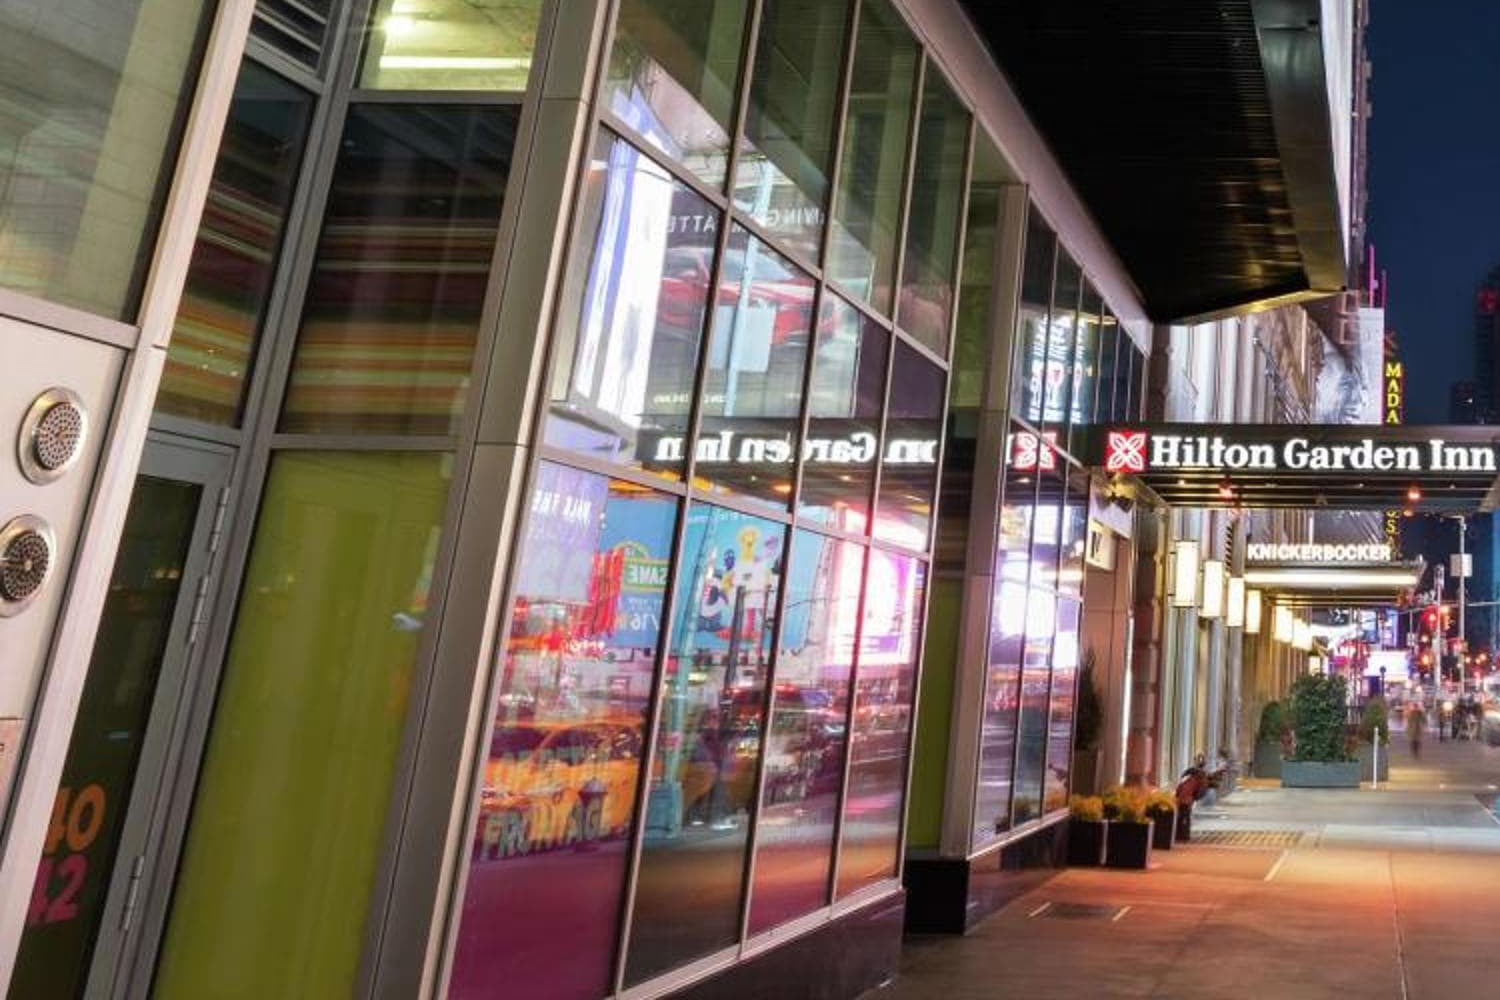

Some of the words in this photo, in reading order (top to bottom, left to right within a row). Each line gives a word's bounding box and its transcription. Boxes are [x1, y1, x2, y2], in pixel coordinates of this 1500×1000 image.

[1385, 362, 1402, 425] MADA
[1149, 434, 1277, 470] Hilton
[1283, 438, 1422, 471] Garden
[1429, 439, 1497, 472] Inn
[1247, 543, 1391, 561] KNICKERBOCKER
